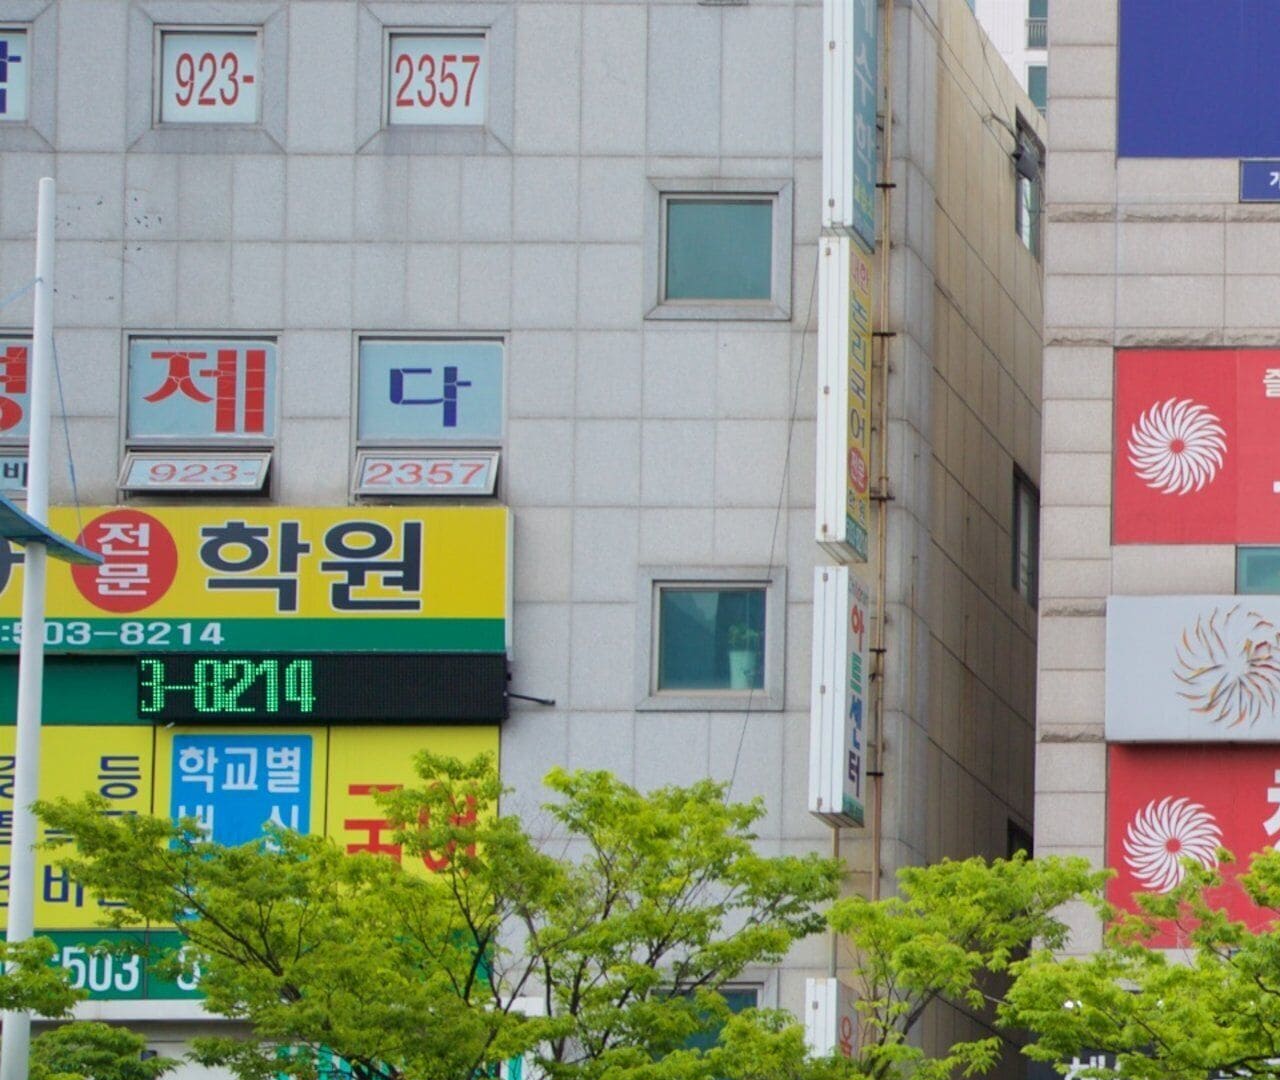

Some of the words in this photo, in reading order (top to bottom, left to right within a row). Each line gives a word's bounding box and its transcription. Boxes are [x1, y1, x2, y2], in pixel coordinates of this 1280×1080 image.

[175, 52, 254, 106] 923-
[395, 54, 480, 107] 2357
[144, 349, 266, 433] 제
[390, 366, 471, 427] 다
[366, 463, 485, 485] 2357
[200, 521, 423, 612] 학원
[179, 746, 301, 794] 학교별
